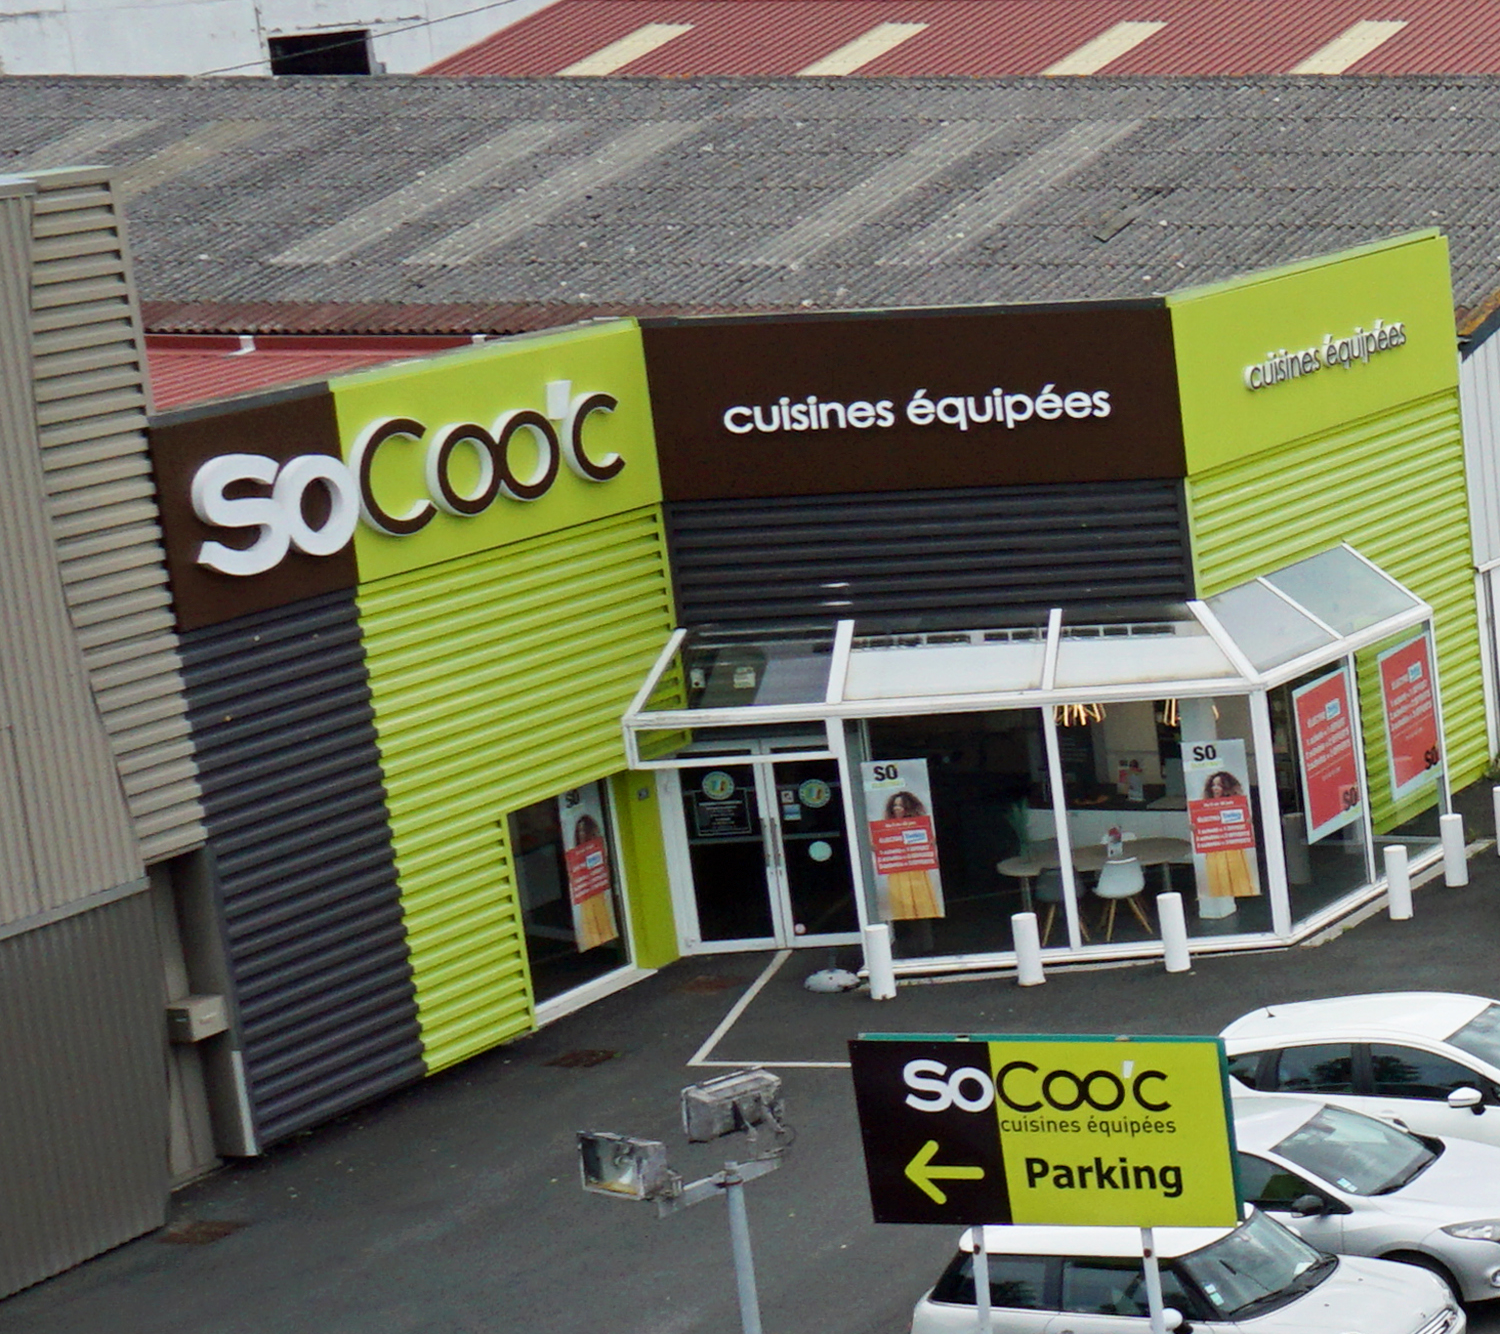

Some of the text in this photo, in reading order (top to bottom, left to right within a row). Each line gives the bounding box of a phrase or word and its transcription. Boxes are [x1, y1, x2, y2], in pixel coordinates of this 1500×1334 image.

[1243, 317, 1407, 391] cuisines équipées
[723, 382, 1112, 435] cuisines équipées
[1000, 1114, 1177, 1138] cuisines équipées
[1024, 1156, 1184, 1198] Parking
